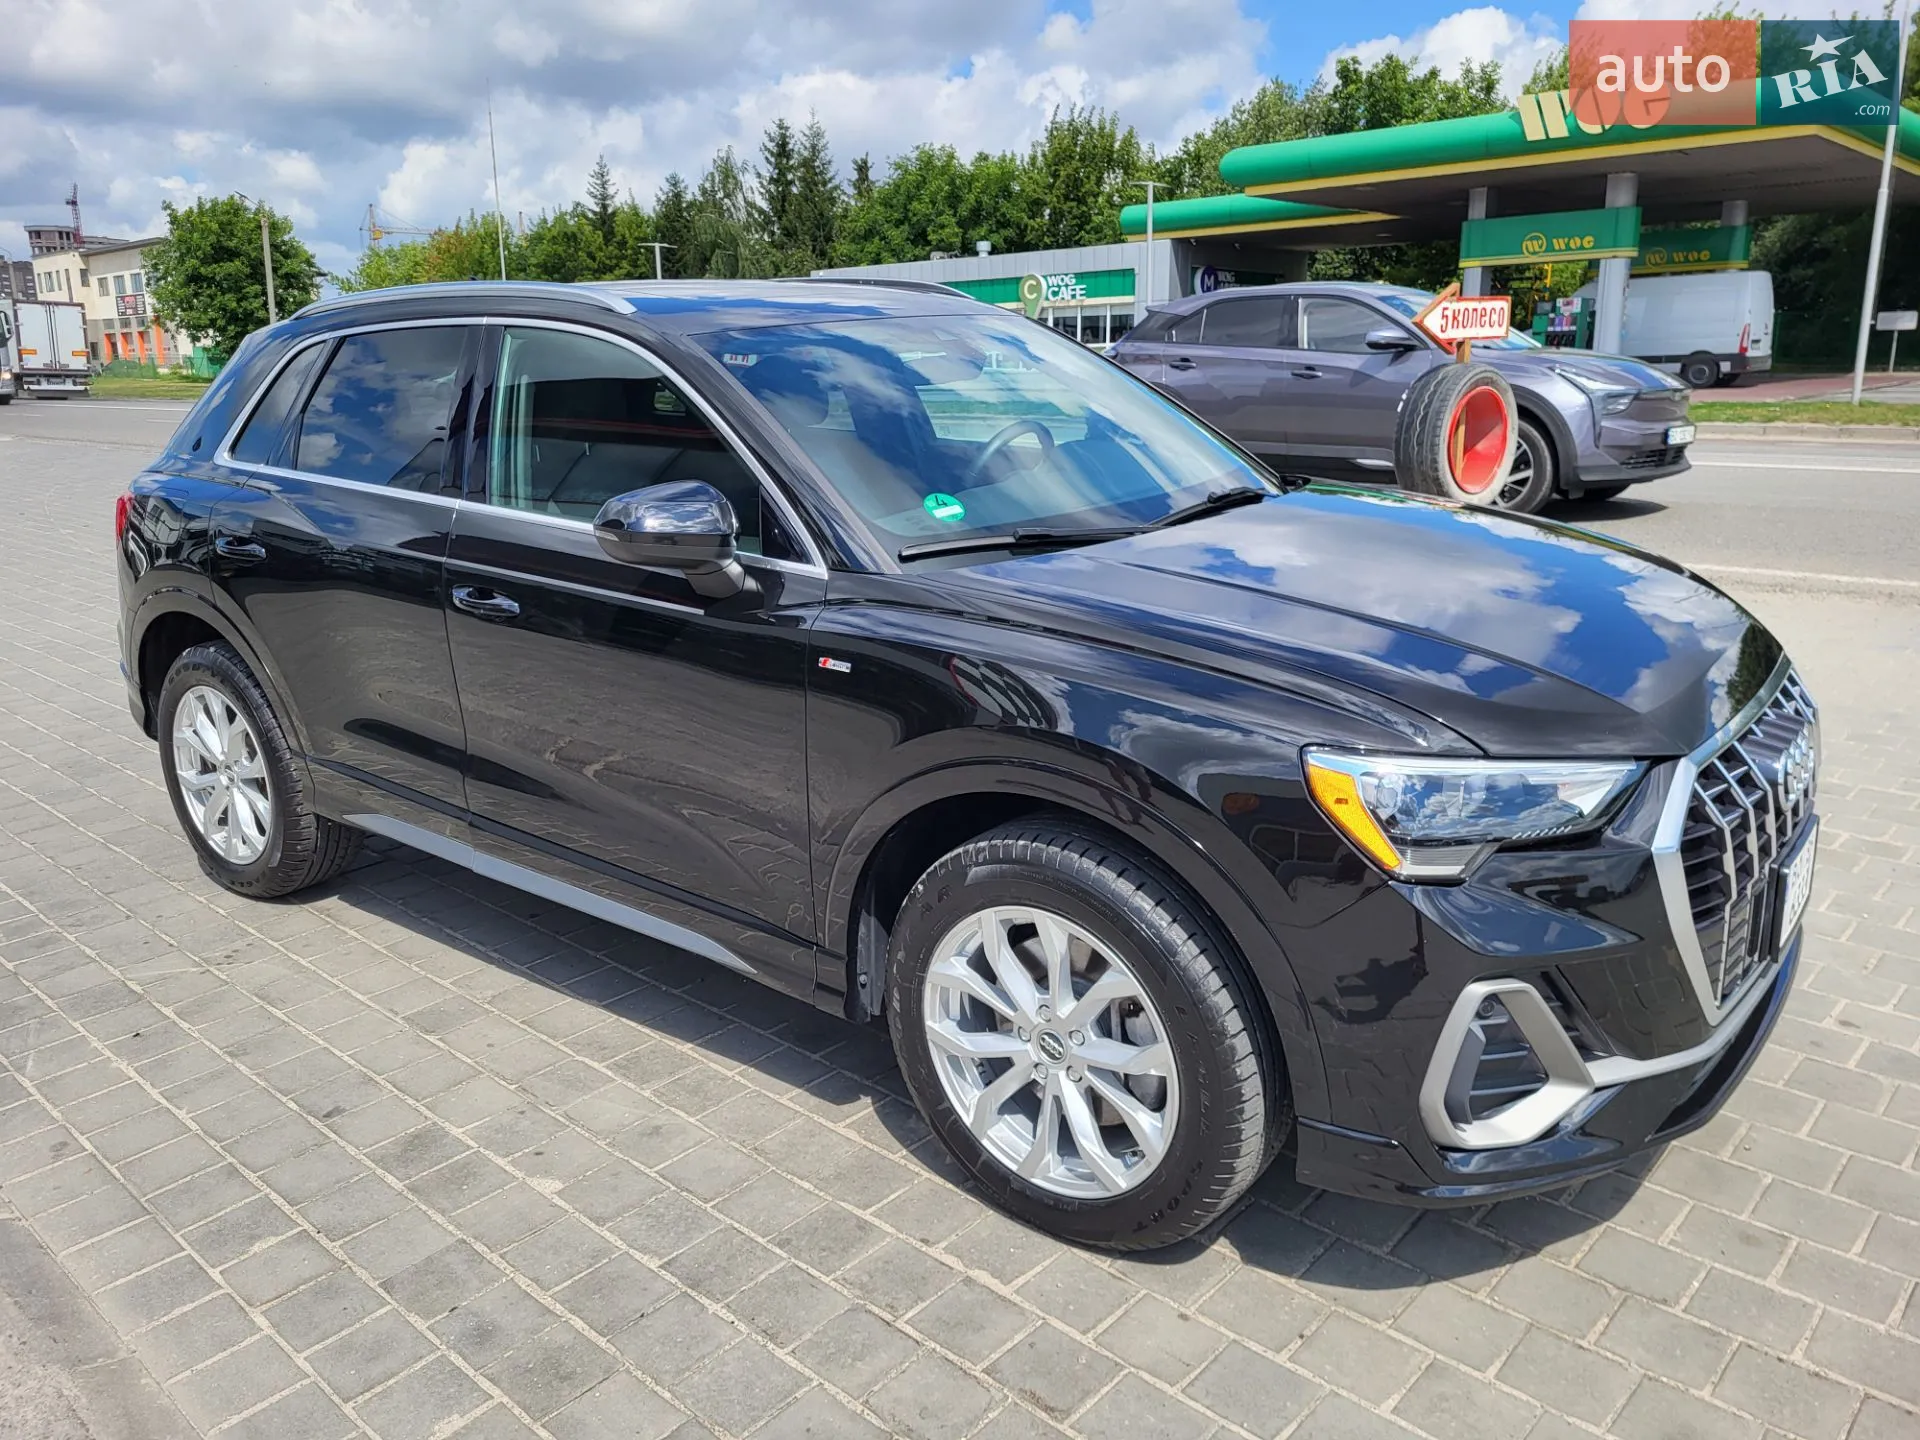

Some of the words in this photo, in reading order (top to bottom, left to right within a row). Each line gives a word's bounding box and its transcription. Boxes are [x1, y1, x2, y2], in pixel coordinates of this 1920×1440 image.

[1552, 235, 1595, 250] WOG
[1672, 250, 1711, 262] WOG
[1046, 274, 1076, 287] WOG
[1047, 285, 1087, 301] CAFE
